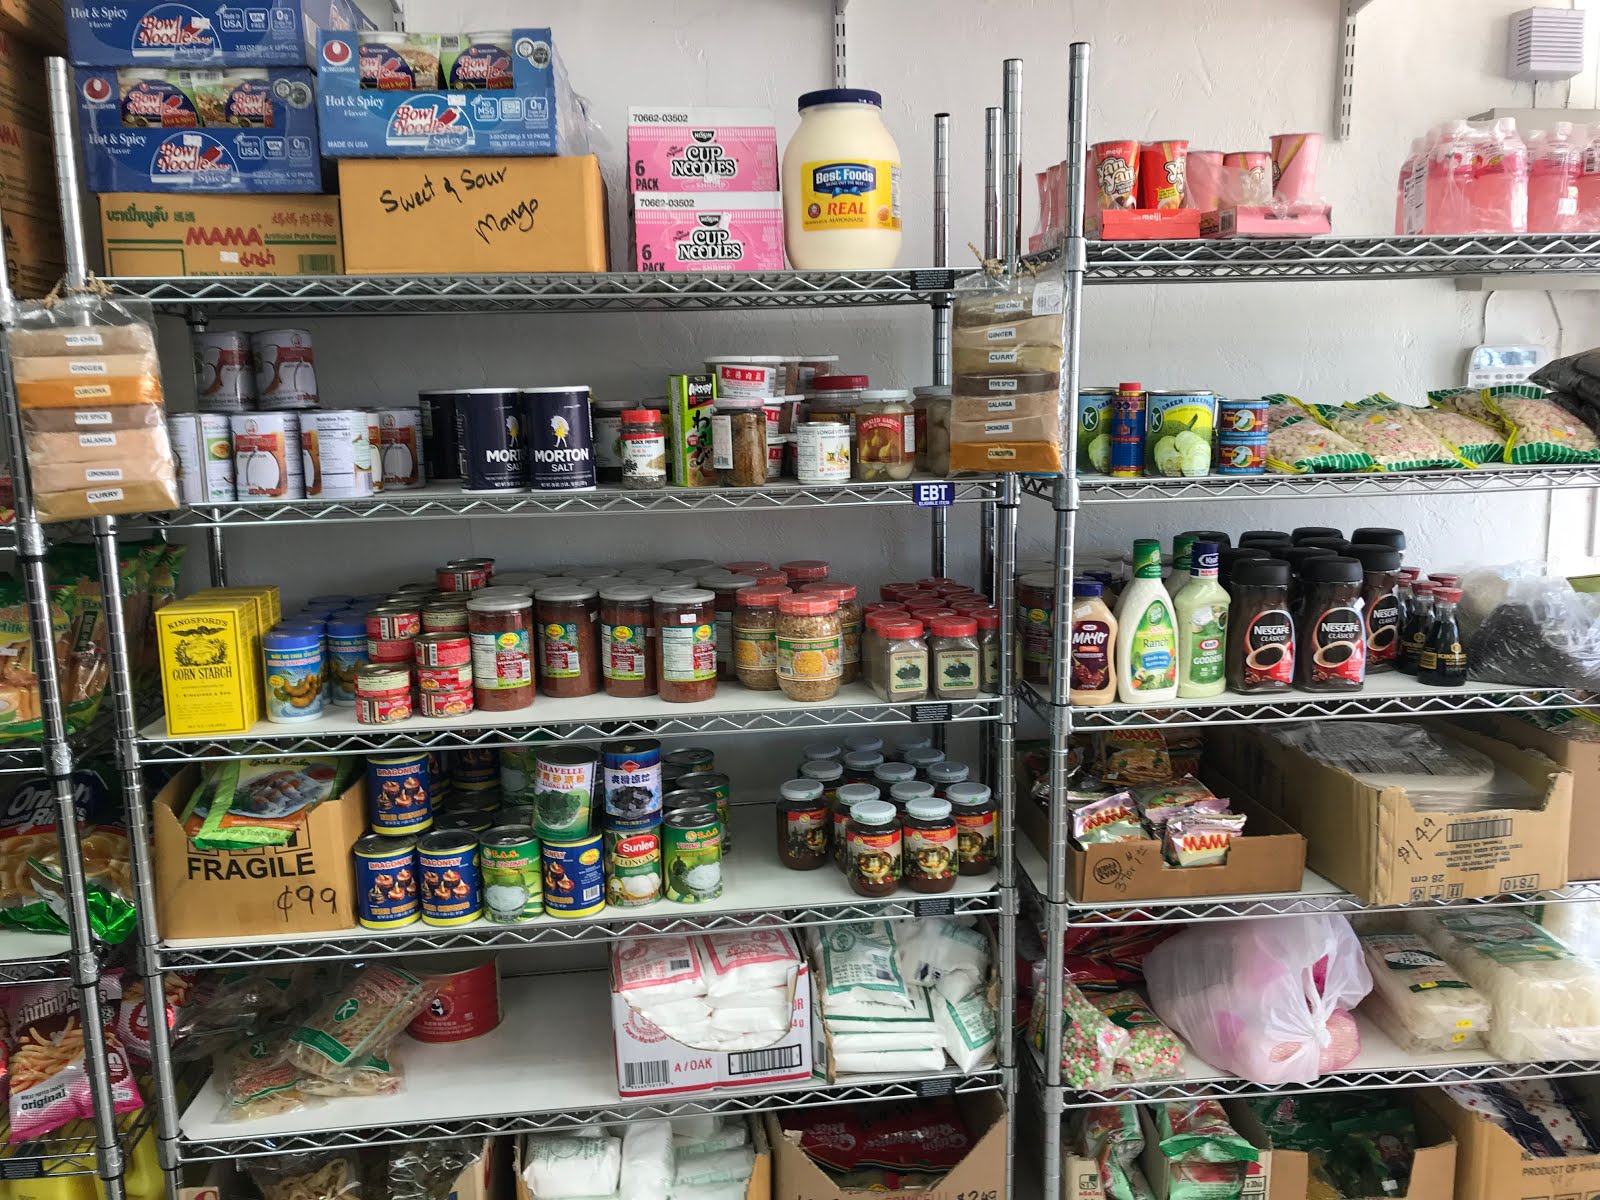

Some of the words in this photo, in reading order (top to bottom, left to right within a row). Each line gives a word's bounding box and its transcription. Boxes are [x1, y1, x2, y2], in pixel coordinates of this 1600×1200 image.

[71, 7, 89, 18] Hot
[91, 8, 100, 18] &
[101, 7, 128, 21] Spicy
[140, 14, 182, 30] Bowl
[223, 20, 243, 28] USA
[138, 31, 190, 47] Noodle
[360, 55, 383, 68] owl
[458, 55, 491, 69] Bowl
[128, 91, 164, 104] Bowl
[231, 91, 267, 104] Bowl
[325, 95, 345, 107] Hot
[347, 96, 356, 107] &
[357, 95, 384, 110] Spicy
[397, 104, 438, 120] Bowl
[632, 114, 689, 122] 70662-03502
[394, 120, 444, 135] Noodle
[88, 133, 107, 144] Hot
[109, 134, 118, 144] &
[119, 133, 147, 147] Spicy
[433, 135, 462, 146] Spicy
[159, 143, 199, 158] Bowl
[241, 147, 259, 155] USA
[685, 145, 722, 161] CUP
[1105, 147, 1123, 155] meiji
[157, 158, 209, 173] Noodle
[634, 160, 646, 177] 6
[671, 159, 735, 177] NOODLES
[815, 169, 841, 184] Best
[843, 168, 874, 182] Foods
[380, 174, 436, 213] Sweet
[460, 166, 507, 190] Sour
[636, 178, 659, 190] PACK
[827, 201, 867, 216] REAL
[475, 198, 539, 244] Mango
[1141, 212, 1162, 221] meiji
[185, 226, 263, 247] MAMA
[692, 230, 729, 245] CUP
[641, 245, 652, 260] 6
[678, 244, 742, 261] NOODLES
[642, 263, 665, 272] PACK
[988, 331, 1013, 339] GINGER
[989, 353, 1015, 361] CURRY
[1161, 397, 1184, 411] GREEN
[534, 448, 589, 462] MORTON
[506, 463, 521, 471] SAL
[551, 463, 575, 472] SALT
[87, 491, 119, 500] CURRY
[920, 485, 948, 500] EBT
[167, 616, 229, 630] KINGSFORD'S
[1072, 632, 1108, 645] MAYO
[1143, 637, 1169, 647] Ranch
[1260, 634, 1286, 642] CLÁSICO
[1193, 655, 1223, 665] GODDESS
[172, 668, 196, 681] CORN
[198, 665, 233, 679] STARCH
[1113, 730, 1161, 740] MAMA
[376, 764, 421, 776] DRAGONFLY
[1082, 805, 1132, 833] MAMA
[621, 840, 655, 853] Sunlee
[1182, 833, 1232, 852] MAMA
[187, 852, 316, 880] FRAGILE
[368, 855, 413, 870] DRAGONFLY
[420, 857, 462, 867] DRAGONFLY
[619, 854, 655, 866] LONGAN
[1097, 869, 1119, 881] WAX
[1411, 875, 1425, 883] cm
[1428, 874, 1445, 882] 28
[1503, 877, 1535, 890] 7810
[18, 992, 66, 1024] shrimp
[637, 1034, 668, 1044] Marketing
[21, 1089, 66, 1111] original
[1521, 1165, 1564, 1176] PRODUCT
[1565, 1164, 1578, 1174] OF
